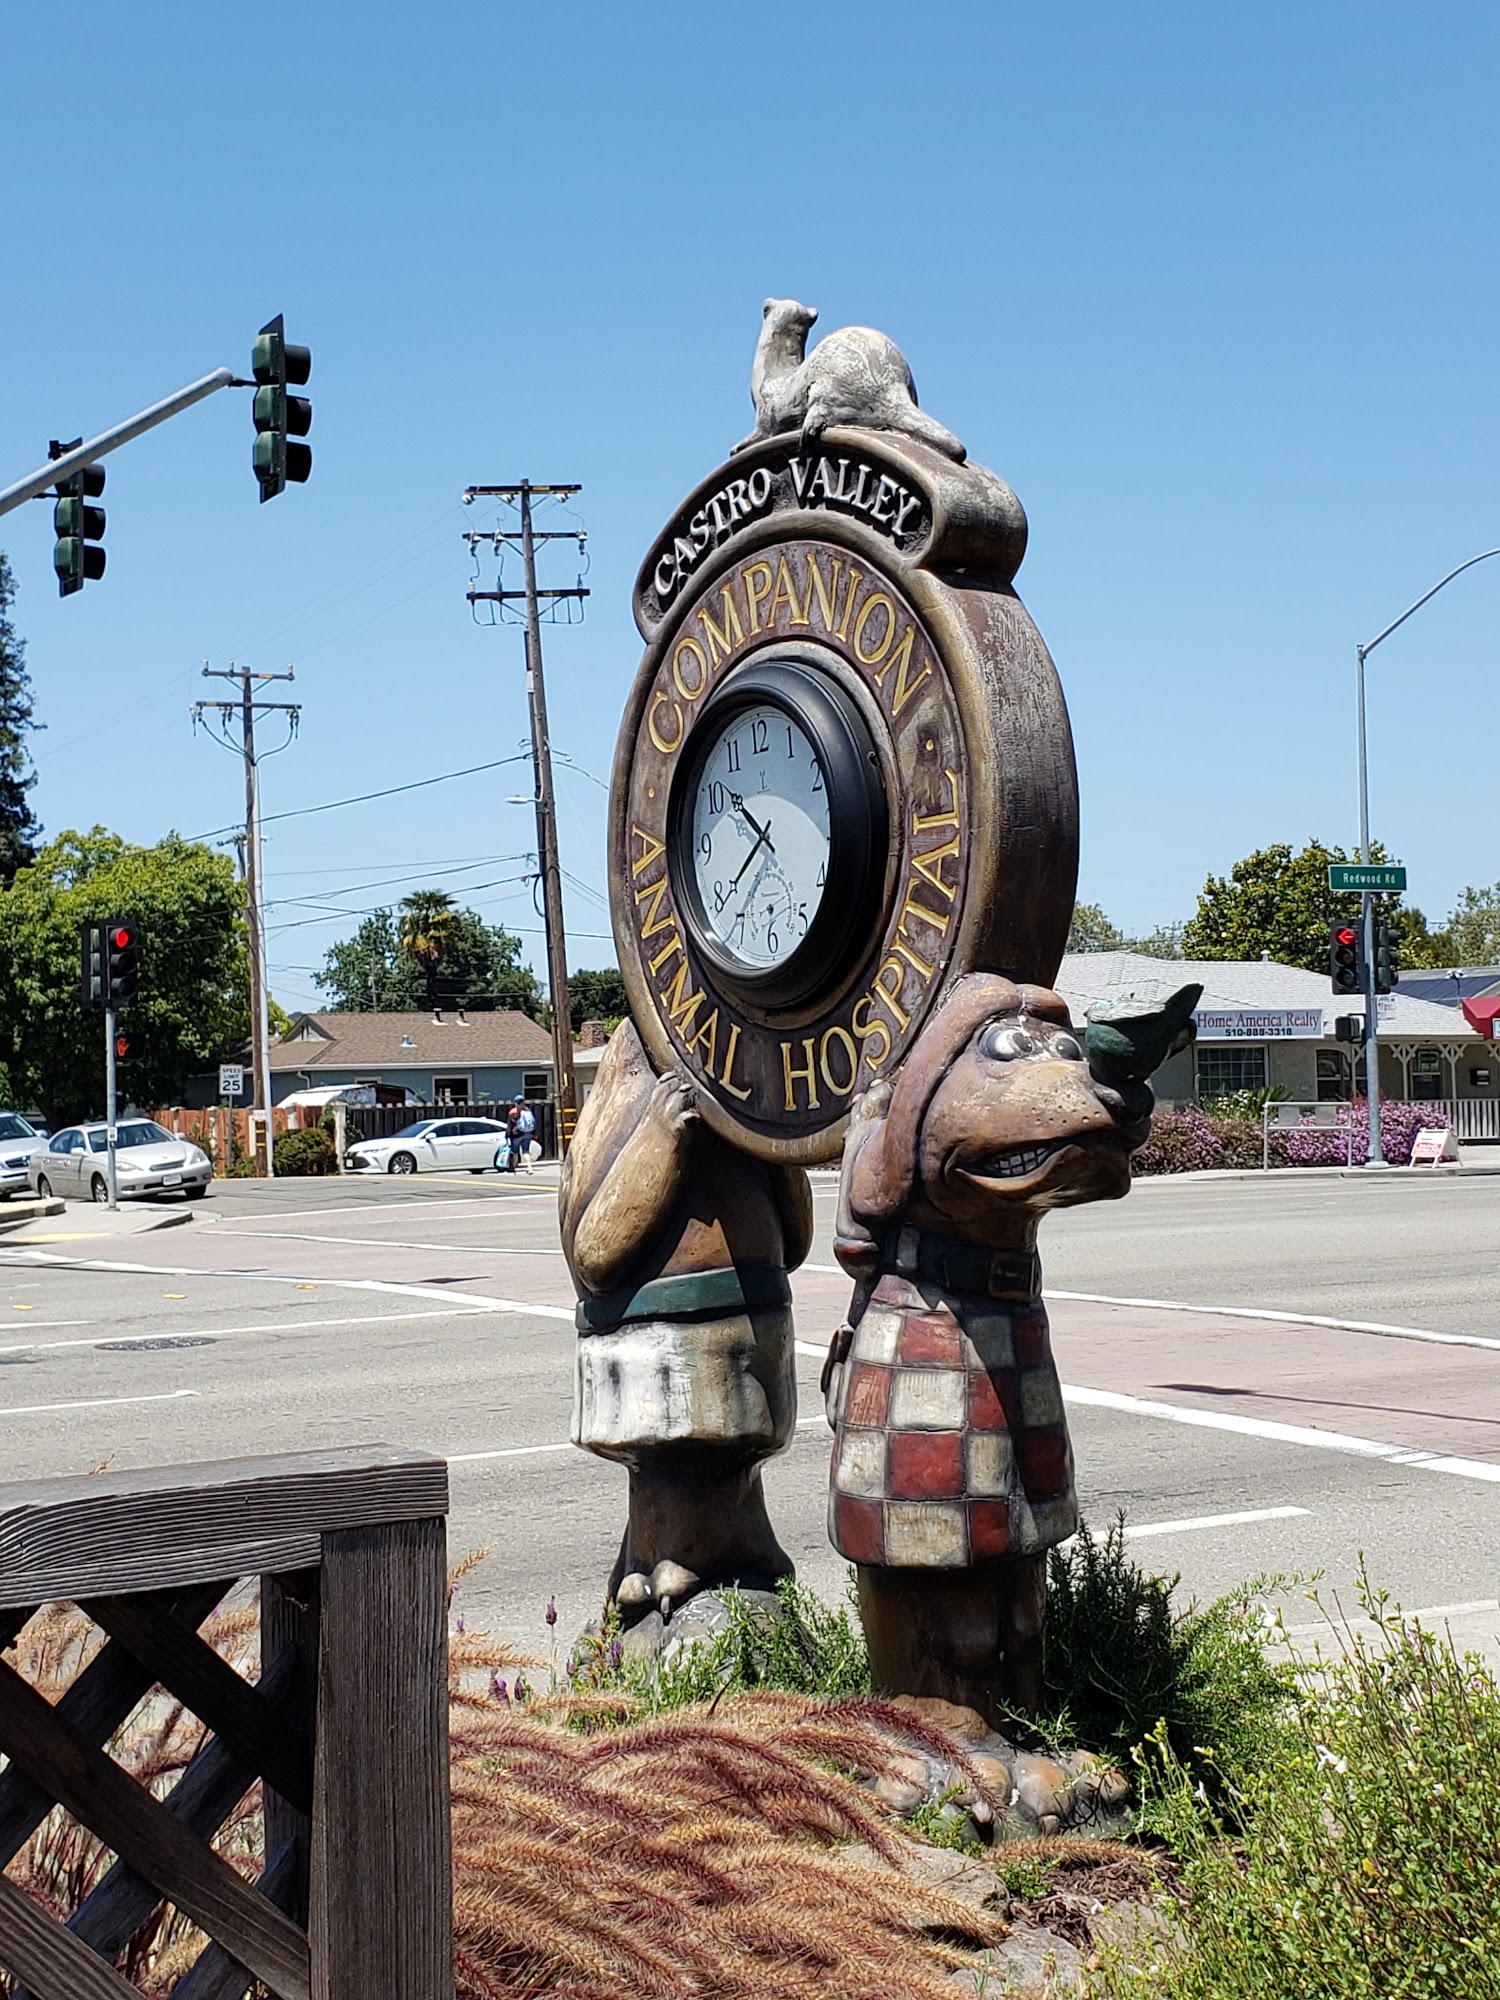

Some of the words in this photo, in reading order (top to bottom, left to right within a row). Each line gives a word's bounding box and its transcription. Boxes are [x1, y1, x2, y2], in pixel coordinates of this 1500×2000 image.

[654, 467, 771, 597] CASTRO
[789, 456, 922, 536] VALLEY
[649, 552, 933, 754] COMPANION
[751, 719, 770, 755] 12
[785, 725, 795, 759] 1
[726, 738, 742, 774] 11
[810, 757, 823, 792] 2
[708, 780, 724, 815] 10
[701, 832, 712, 866] 9
[816, 861, 827, 887] 4
[1342, 872, 1381, 884] Redwood
[1384, 873, 1396, 885] Rd
[713, 880, 724, 913] 8
[736, 913, 746, 945] 7
[798, 903, 808, 936] 5
[632, 824, 752, 1101] ANIMAL
[779, 769, 961, 1111] HOSPITAL
[767, 920, 779, 954] 6
[1196, 1012, 1232, 1028] Home
[1236, 1012, 1282, 1028] America
[1286, 1011, 1319, 1031] Realty
[222, 1080, 241, 1091] 25
